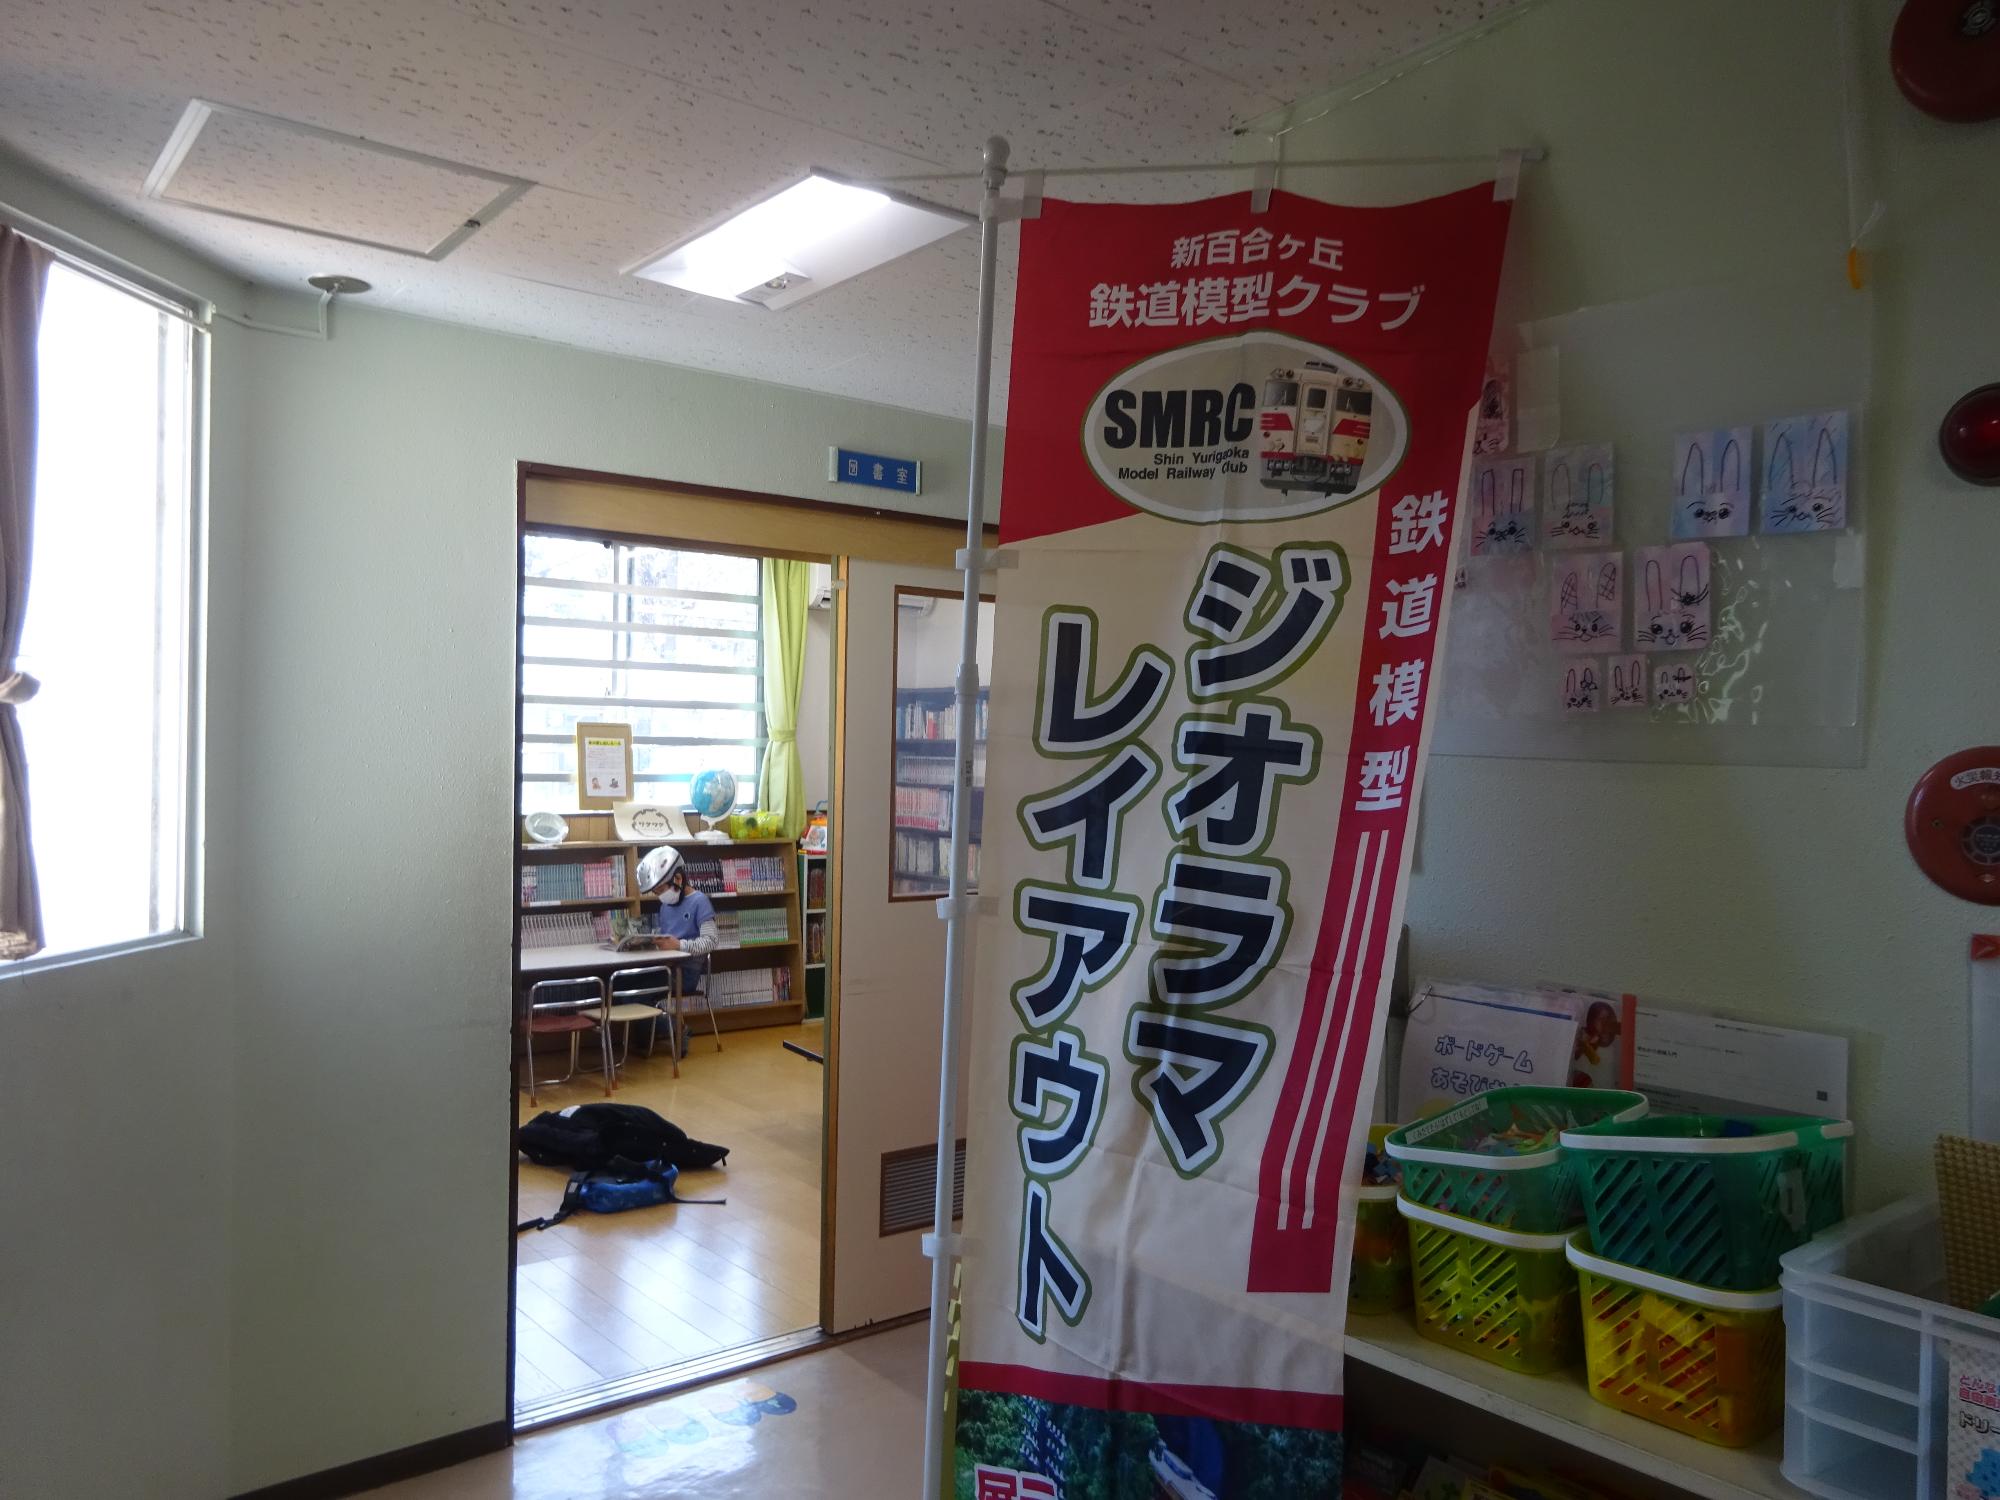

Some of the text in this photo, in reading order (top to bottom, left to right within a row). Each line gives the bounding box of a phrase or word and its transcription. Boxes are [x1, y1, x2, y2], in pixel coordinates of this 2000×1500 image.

[1088, 272, 1427, 331] 鉄道模型クラブ
[1104, 383, 1256, 449] SMRC
[1118, 467, 1159, 480] Model
[1166, 466, 1216, 481] Railway
[1153, 446, 1250, 466] Shin Yurigaoka
[1354, 490, 1449, 813] 鉄道模型
[1130, 550, 1341, 1168] ジオラマ
[1015, 613, 1170, 1335] レイアウト
[1434, 1034, 1534, 1074] ボードゲーム
